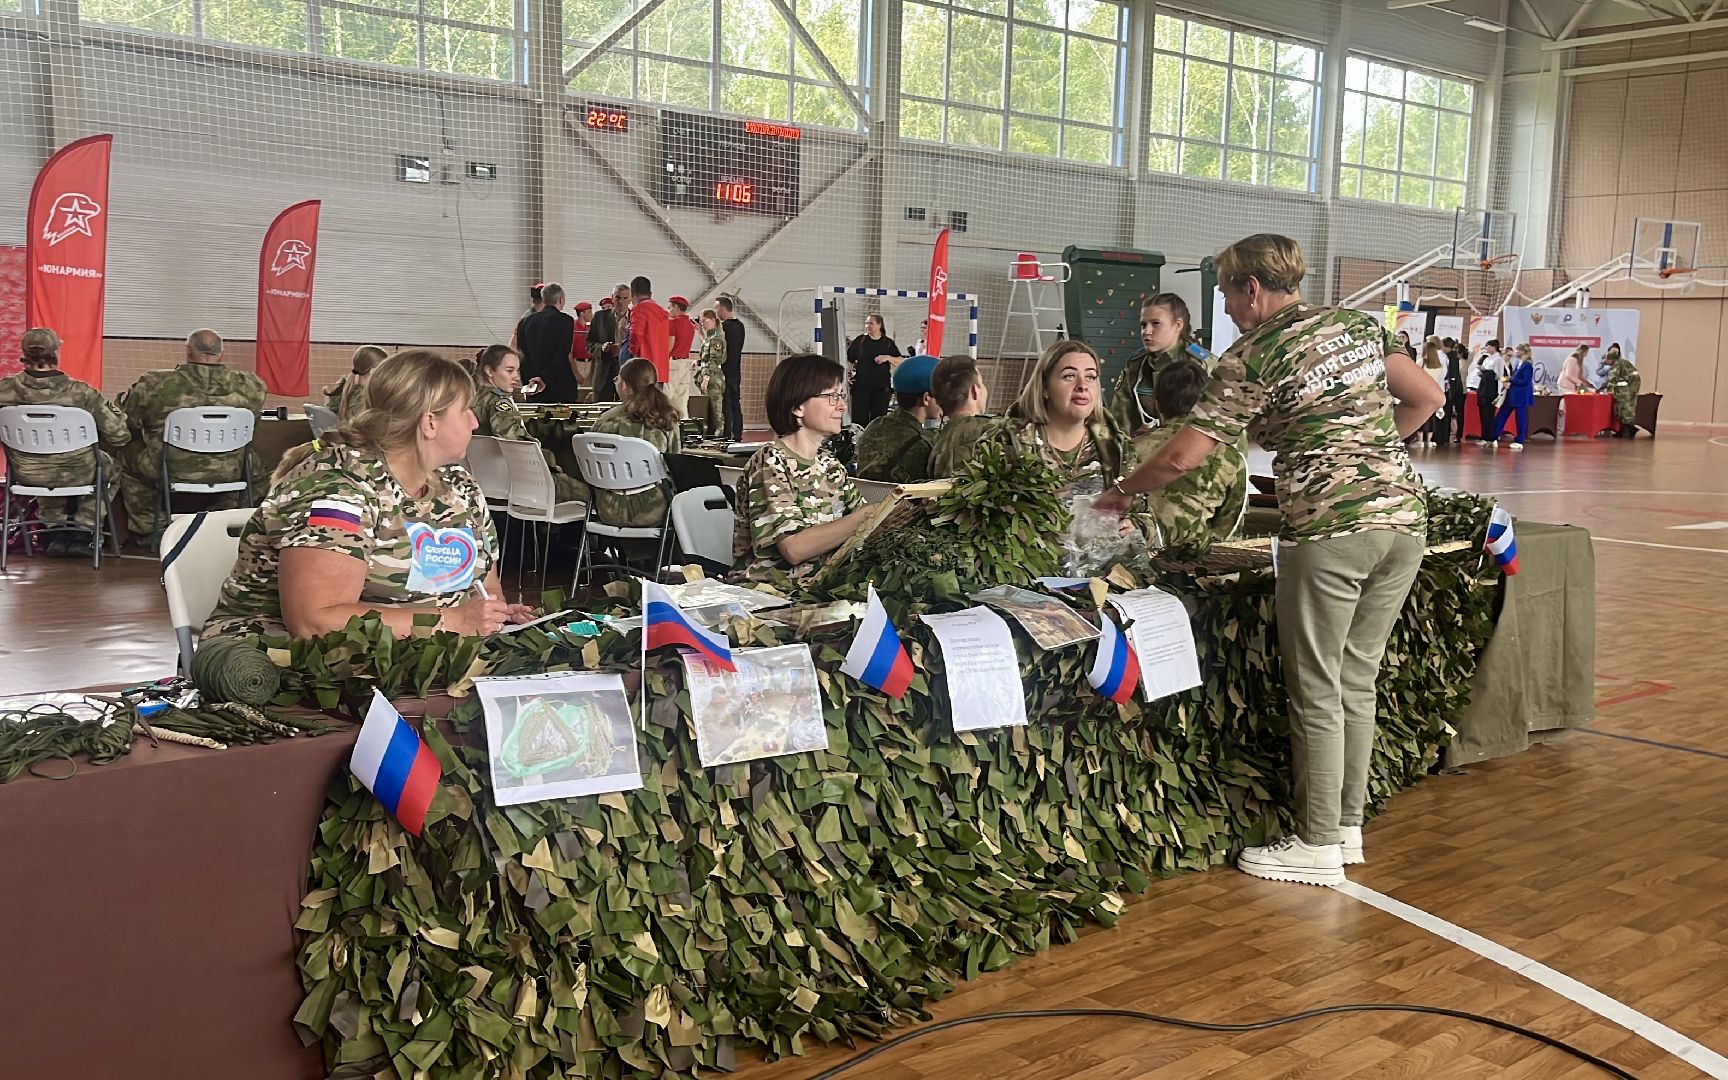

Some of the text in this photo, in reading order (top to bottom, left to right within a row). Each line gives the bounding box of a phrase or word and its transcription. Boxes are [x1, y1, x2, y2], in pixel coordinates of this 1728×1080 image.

[1316, 332, 1354, 355] СЕТИ
[1304, 357, 1338, 386] ДЛЯ
[425, 545, 461, 556] СЕРДЦА
[425, 554, 462, 565] РОССИИ
